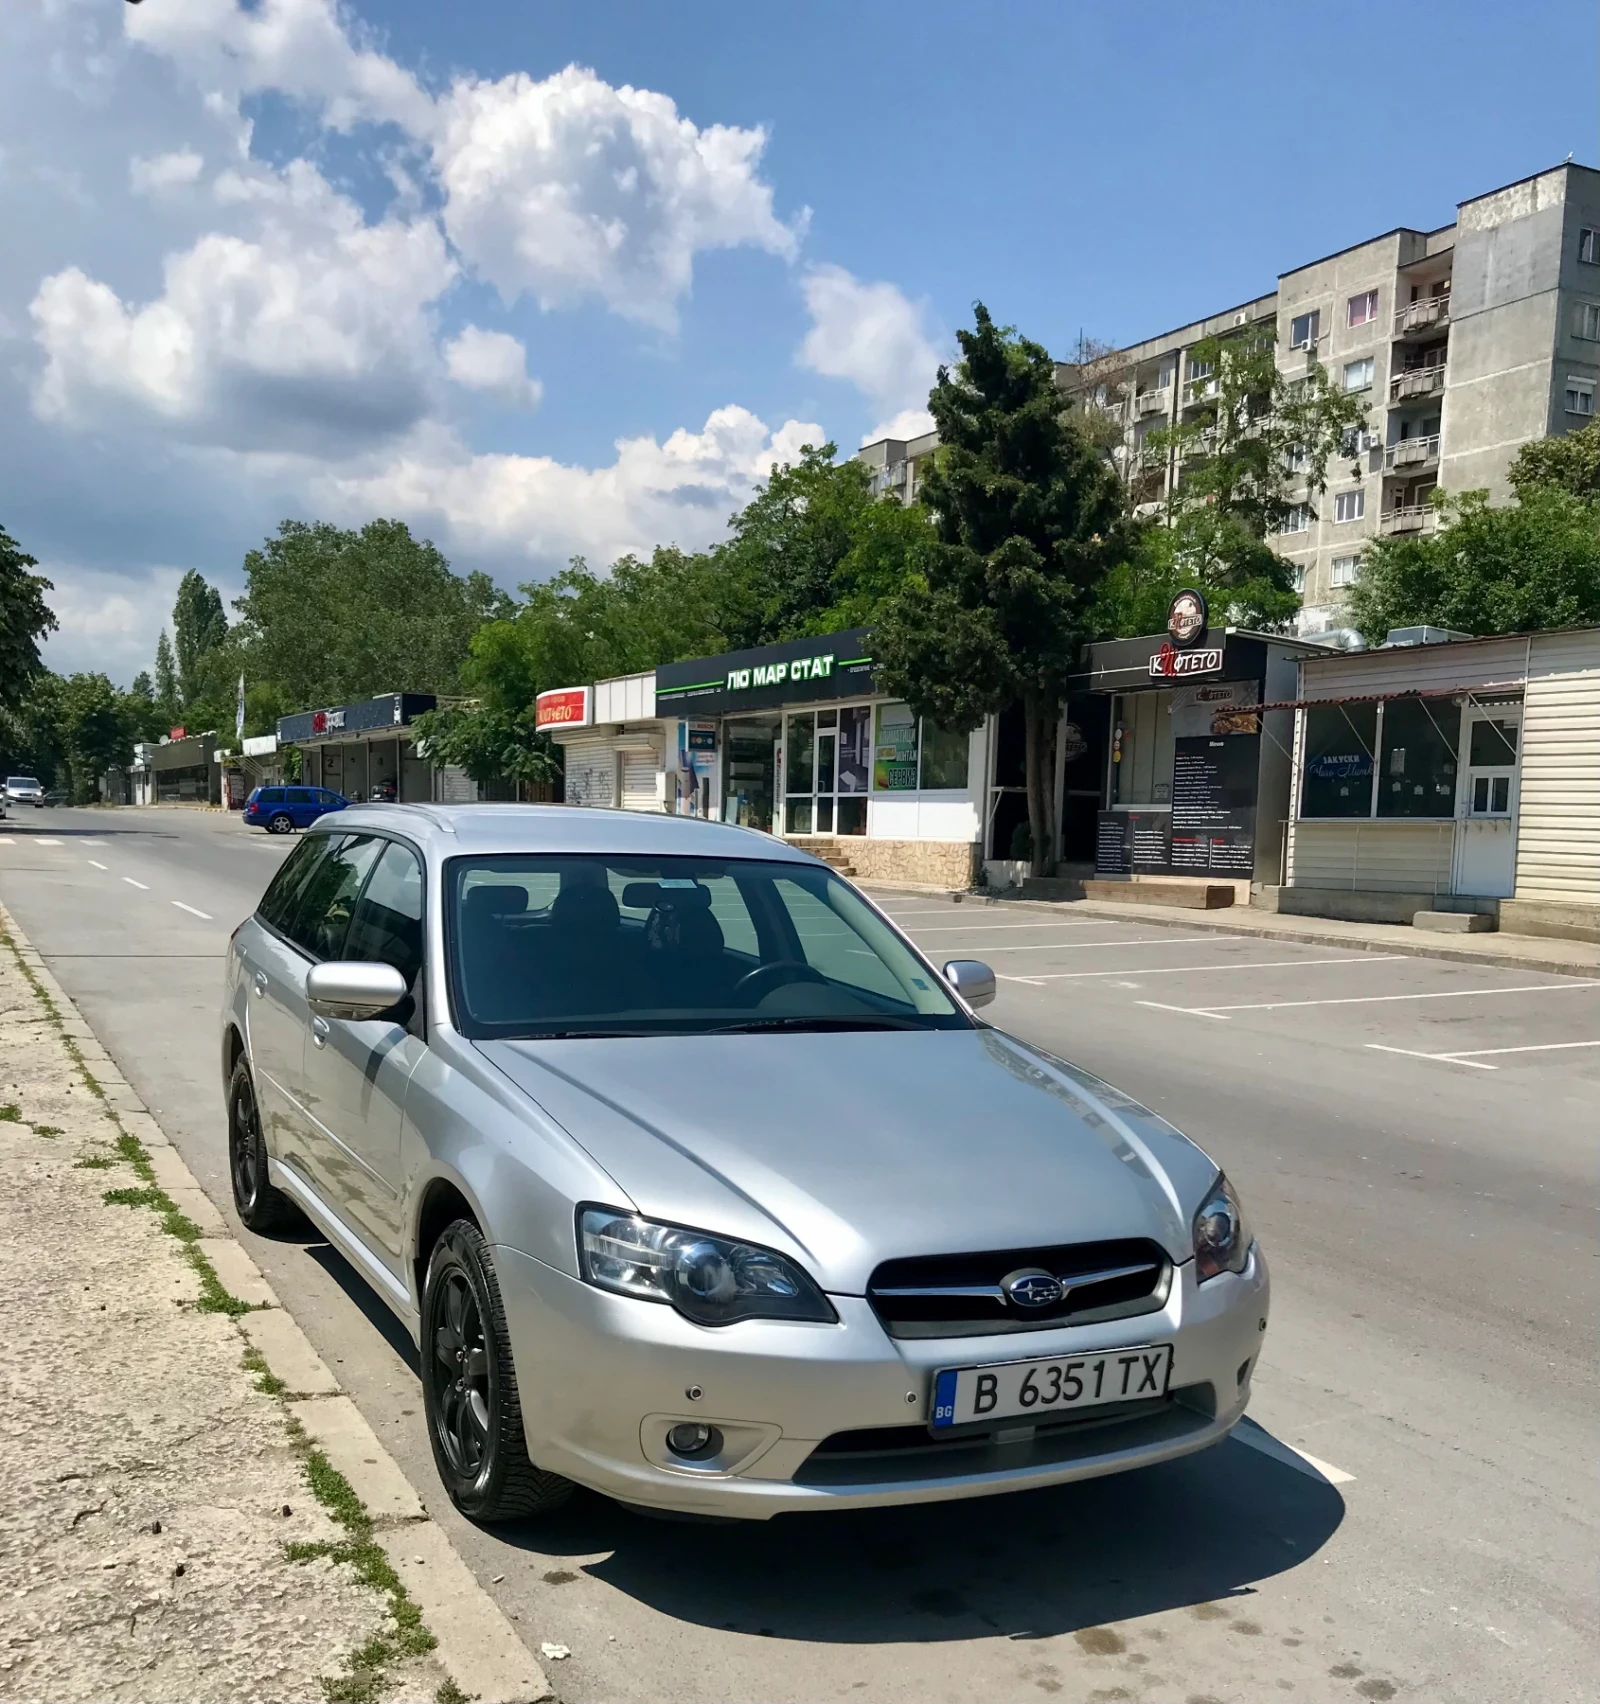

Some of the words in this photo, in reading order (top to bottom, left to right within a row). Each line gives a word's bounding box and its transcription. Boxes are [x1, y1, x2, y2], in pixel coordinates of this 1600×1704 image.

[727, 669, 750, 690] ЛЮ
[753, 662, 788, 686] МАР
[790, 654, 834, 680] СТАТ
[327, 758, 334, 768] 2
[1322, 755, 1360, 764] ЗАКУСКИ
[973, 1374, 998, 1415] B
[1019, 1360, 1105, 1407] 6351
[1118, 1353, 1162, 1395] TX
[936, 1405, 953, 1419] BG
